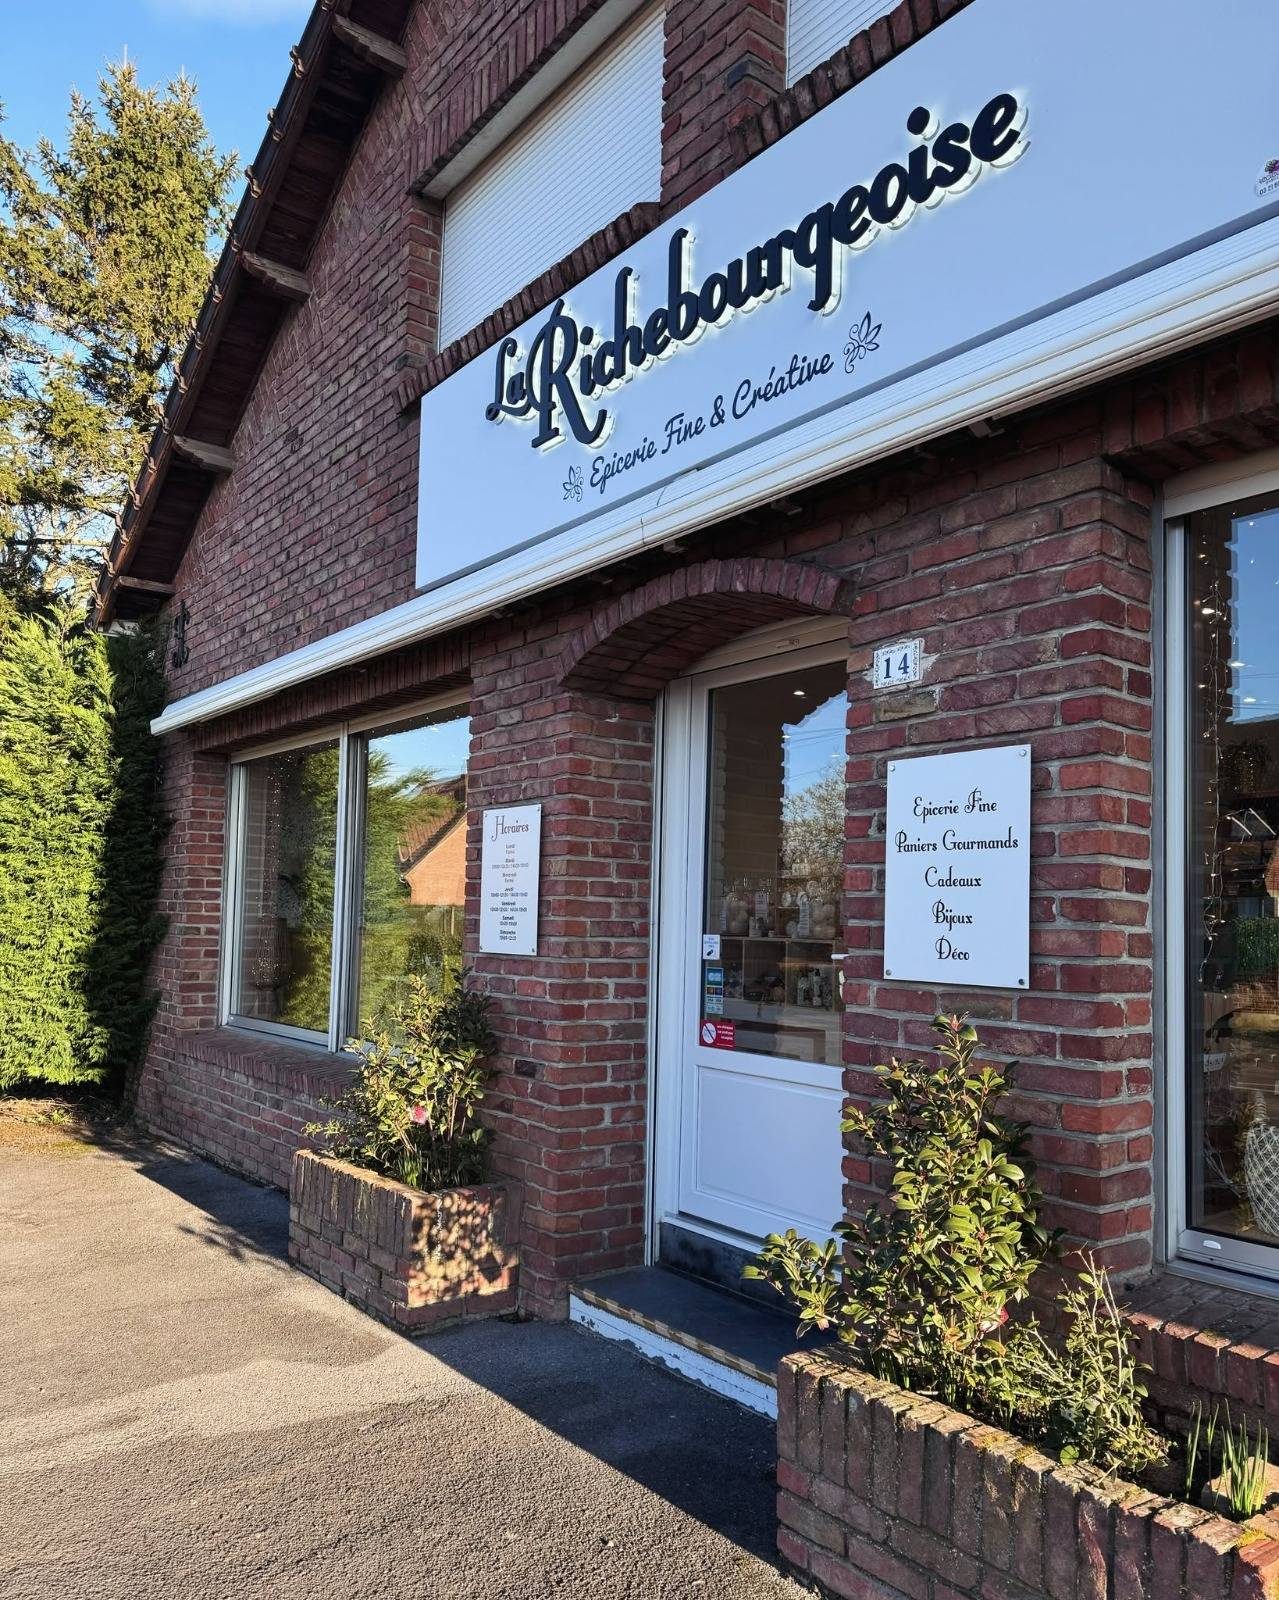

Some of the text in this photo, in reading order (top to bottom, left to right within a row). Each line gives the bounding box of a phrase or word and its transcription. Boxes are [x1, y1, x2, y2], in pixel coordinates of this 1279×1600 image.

[485, 93, 1019, 448] La Richebourgeoise
[590, 353, 834, 494] Epicerie Fine & Créative
[883, 653, 910, 679] 14
[913, 788, 998, 823] Epicerie Fine
[491, 815, 529, 841] Horaires
[895, 826, 1019, 853] Paniers Gourmands
[924, 866, 982, 888] Cadeaux
[932, 899, 973, 931] Bijoux
[935, 935, 970, 960] Déco
